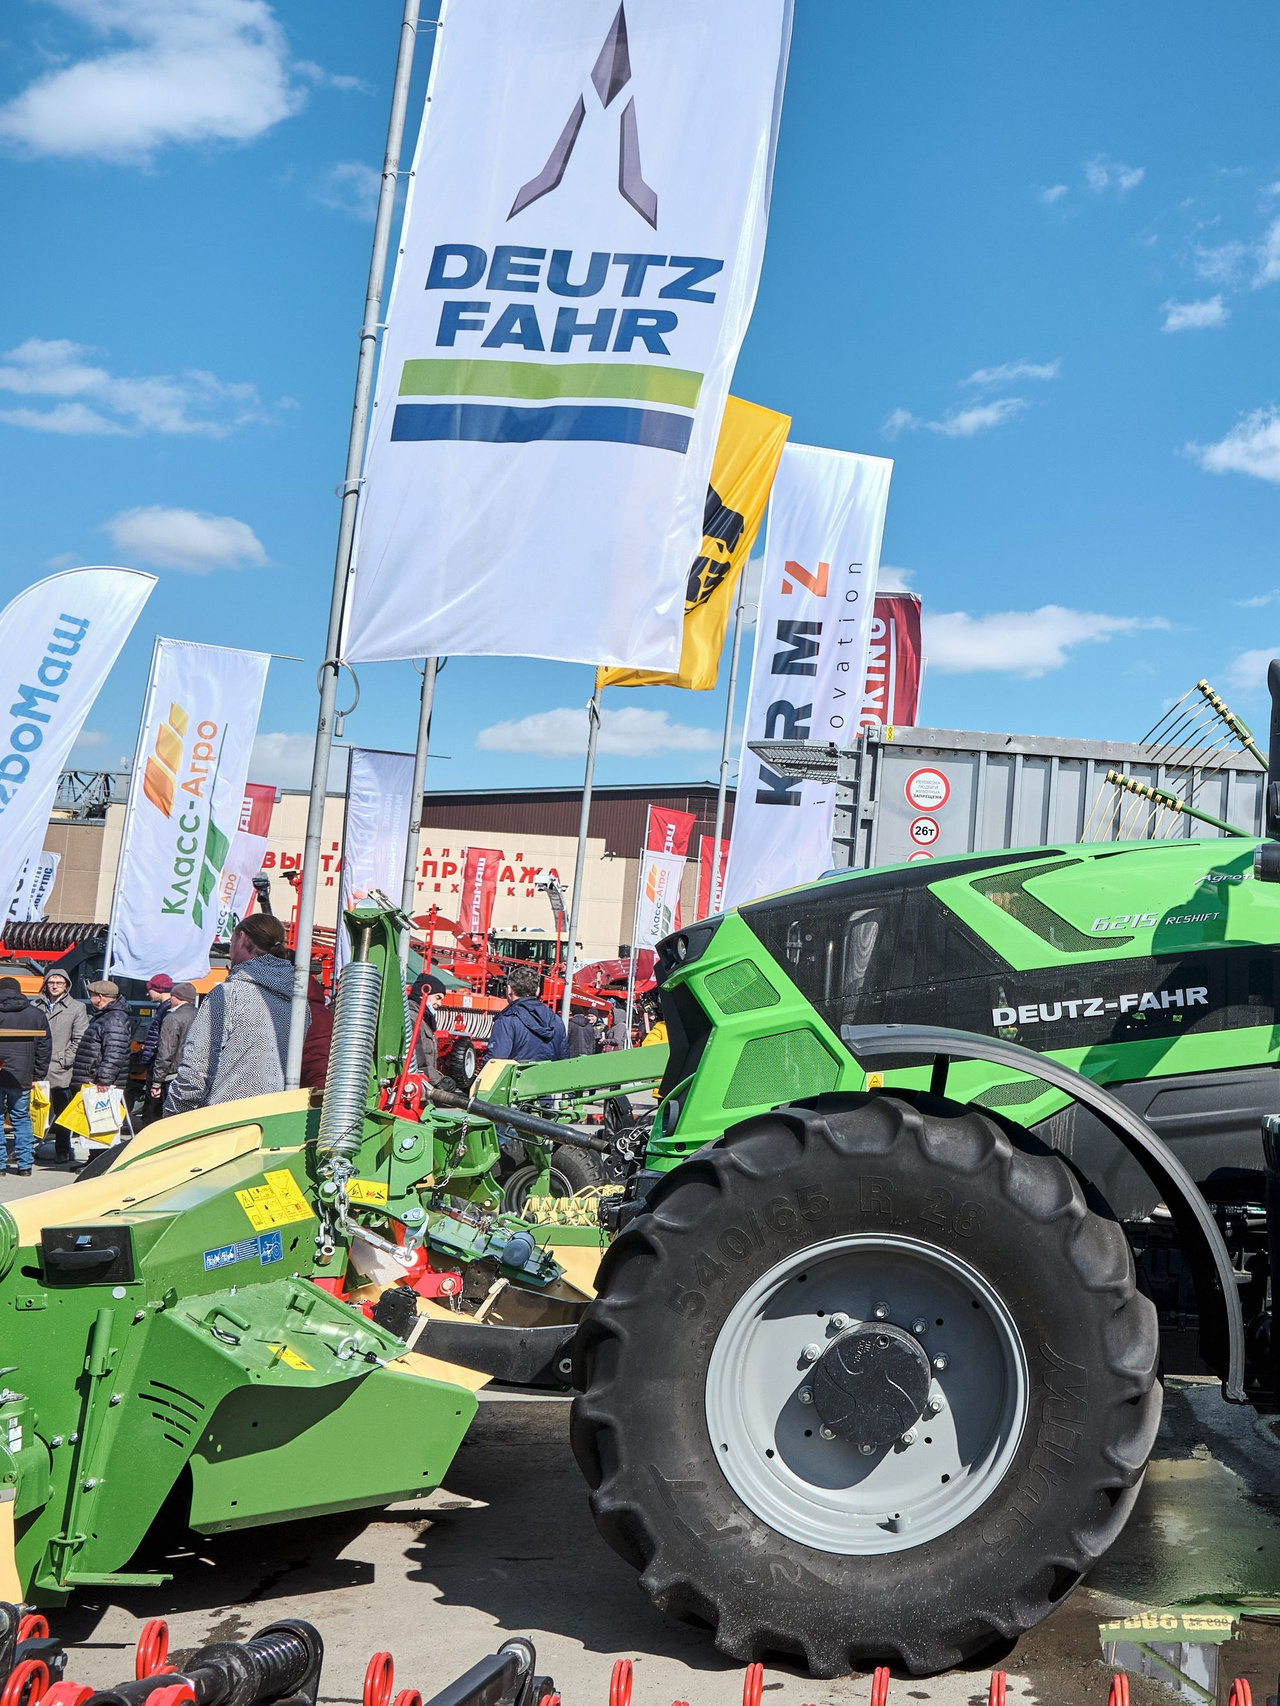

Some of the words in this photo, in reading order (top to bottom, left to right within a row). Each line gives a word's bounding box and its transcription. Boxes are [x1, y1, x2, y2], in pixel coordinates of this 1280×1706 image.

[425, 243, 724, 304] DEUTZ
[435, 300, 679, 355] FAHR
[161, 720, 218, 915] Класс-Агро
[471, 857, 486, 934] СЕЛЬМАШ
[651, 869, 667, 936] Класс-Агро
[1091, 912, 1159, 932] 6215
[1165, 912, 1221, 925] RCSHIFT
[991, 986, 1209, 1028] DEUTZ-FAHR
[664, 1181, 832, 1320] 540/65
[859, 1175, 894, 1215] R
[919, 1185, 987, 1239] 28
